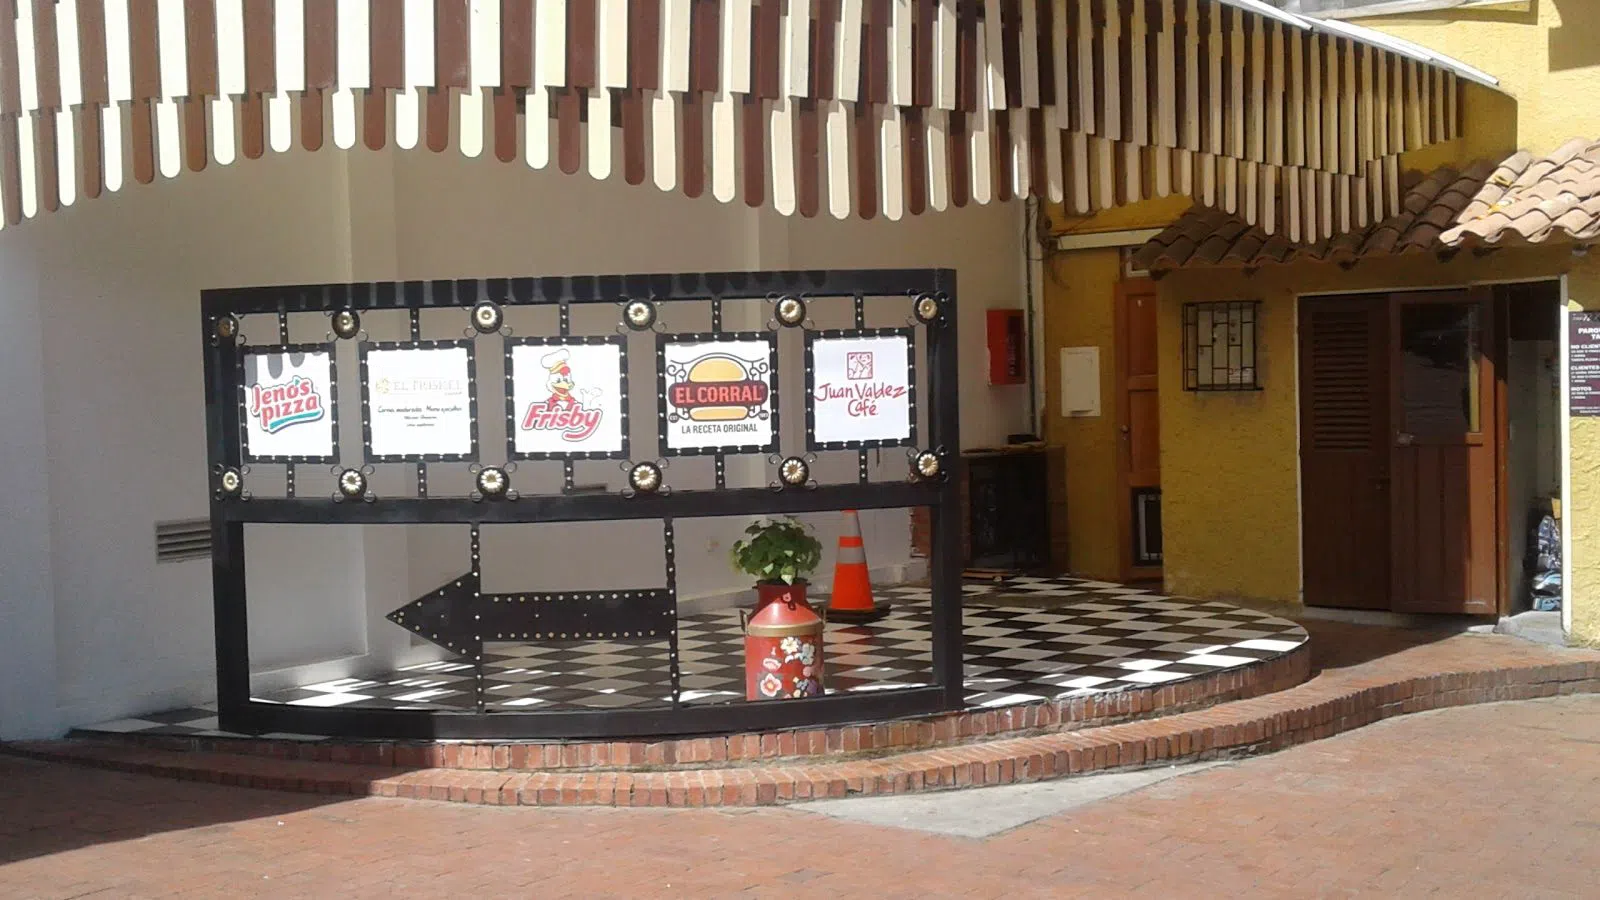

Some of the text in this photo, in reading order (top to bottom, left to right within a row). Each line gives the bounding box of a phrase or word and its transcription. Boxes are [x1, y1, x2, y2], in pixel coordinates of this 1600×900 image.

[252, 376, 310, 412] Jeno's
[675, 385, 762, 404] EL CORRAL
[814, 382, 906, 401] Juan Valdez
[262, 395, 318, 428] pizza
[848, 399, 877, 417] Café
[522, 403, 601, 440] Frisby
[681, 423, 758, 434] LA RECETA ORIGINAL
